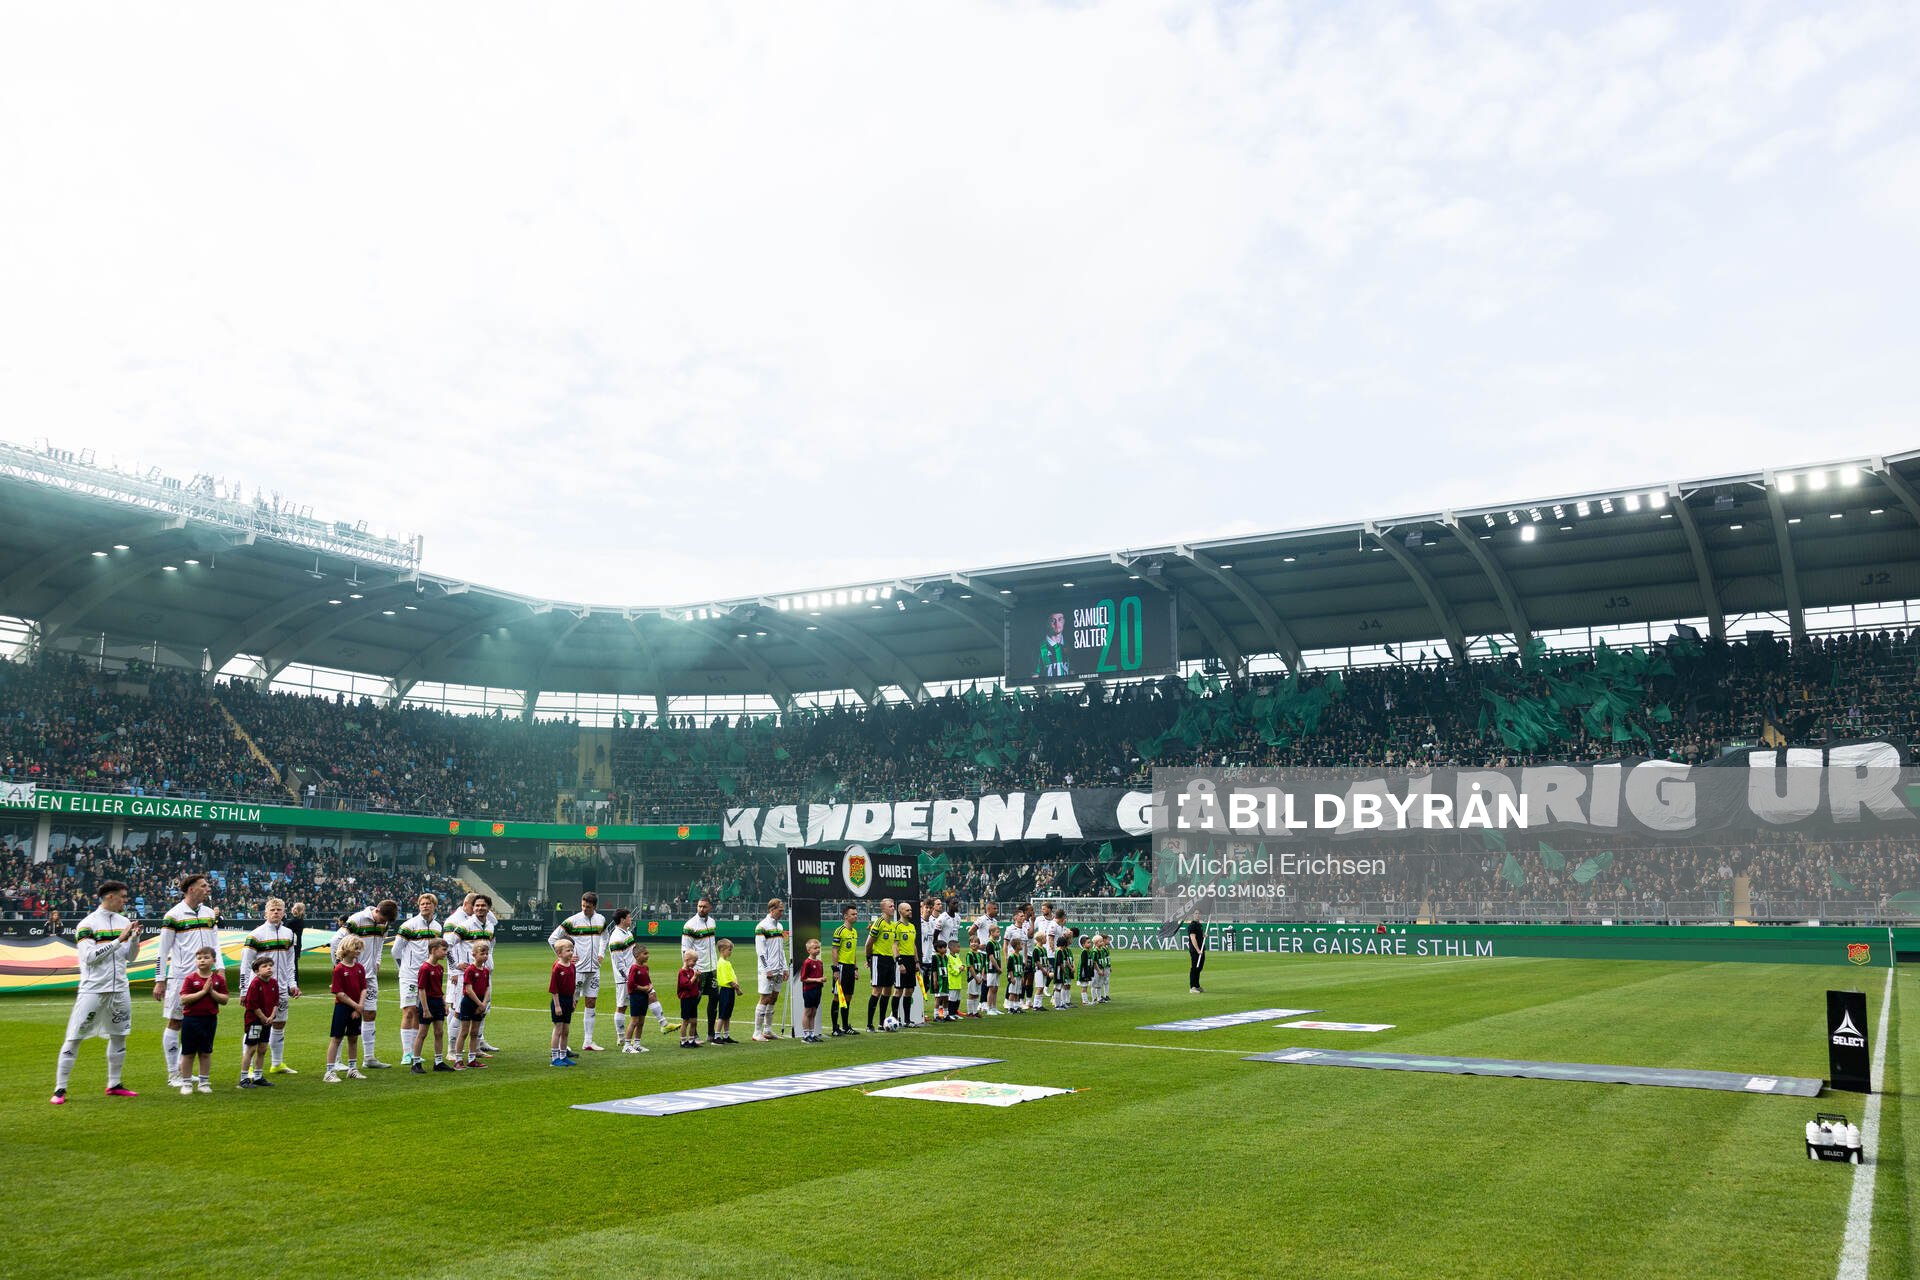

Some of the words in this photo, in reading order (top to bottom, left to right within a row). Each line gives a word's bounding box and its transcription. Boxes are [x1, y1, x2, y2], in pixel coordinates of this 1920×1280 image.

[1604, 595, 1631, 608] J3
[1073, 606, 1110, 628] SAMUEL
[1073, 628, 1108, 649] SALTER
[1096, 595, 1143, 673] 20
[1747, 741, 1918, 825] UR
[70, 797, 124, 813] ELLER
[131, 801, 203, 818] GAISARE
[209, 806, 260, 821] STHLM
[797, 859, 836, 876] UNIBET
[878, 863, 912, 879] UNIBET
[1243, 936, 1304, 953] ELLER
[1313, 937, 1407, 956] GAISARE
[1417, 939, 1494, 957] STHLM
[1832, 1035, 1865, 1048] SELECT
